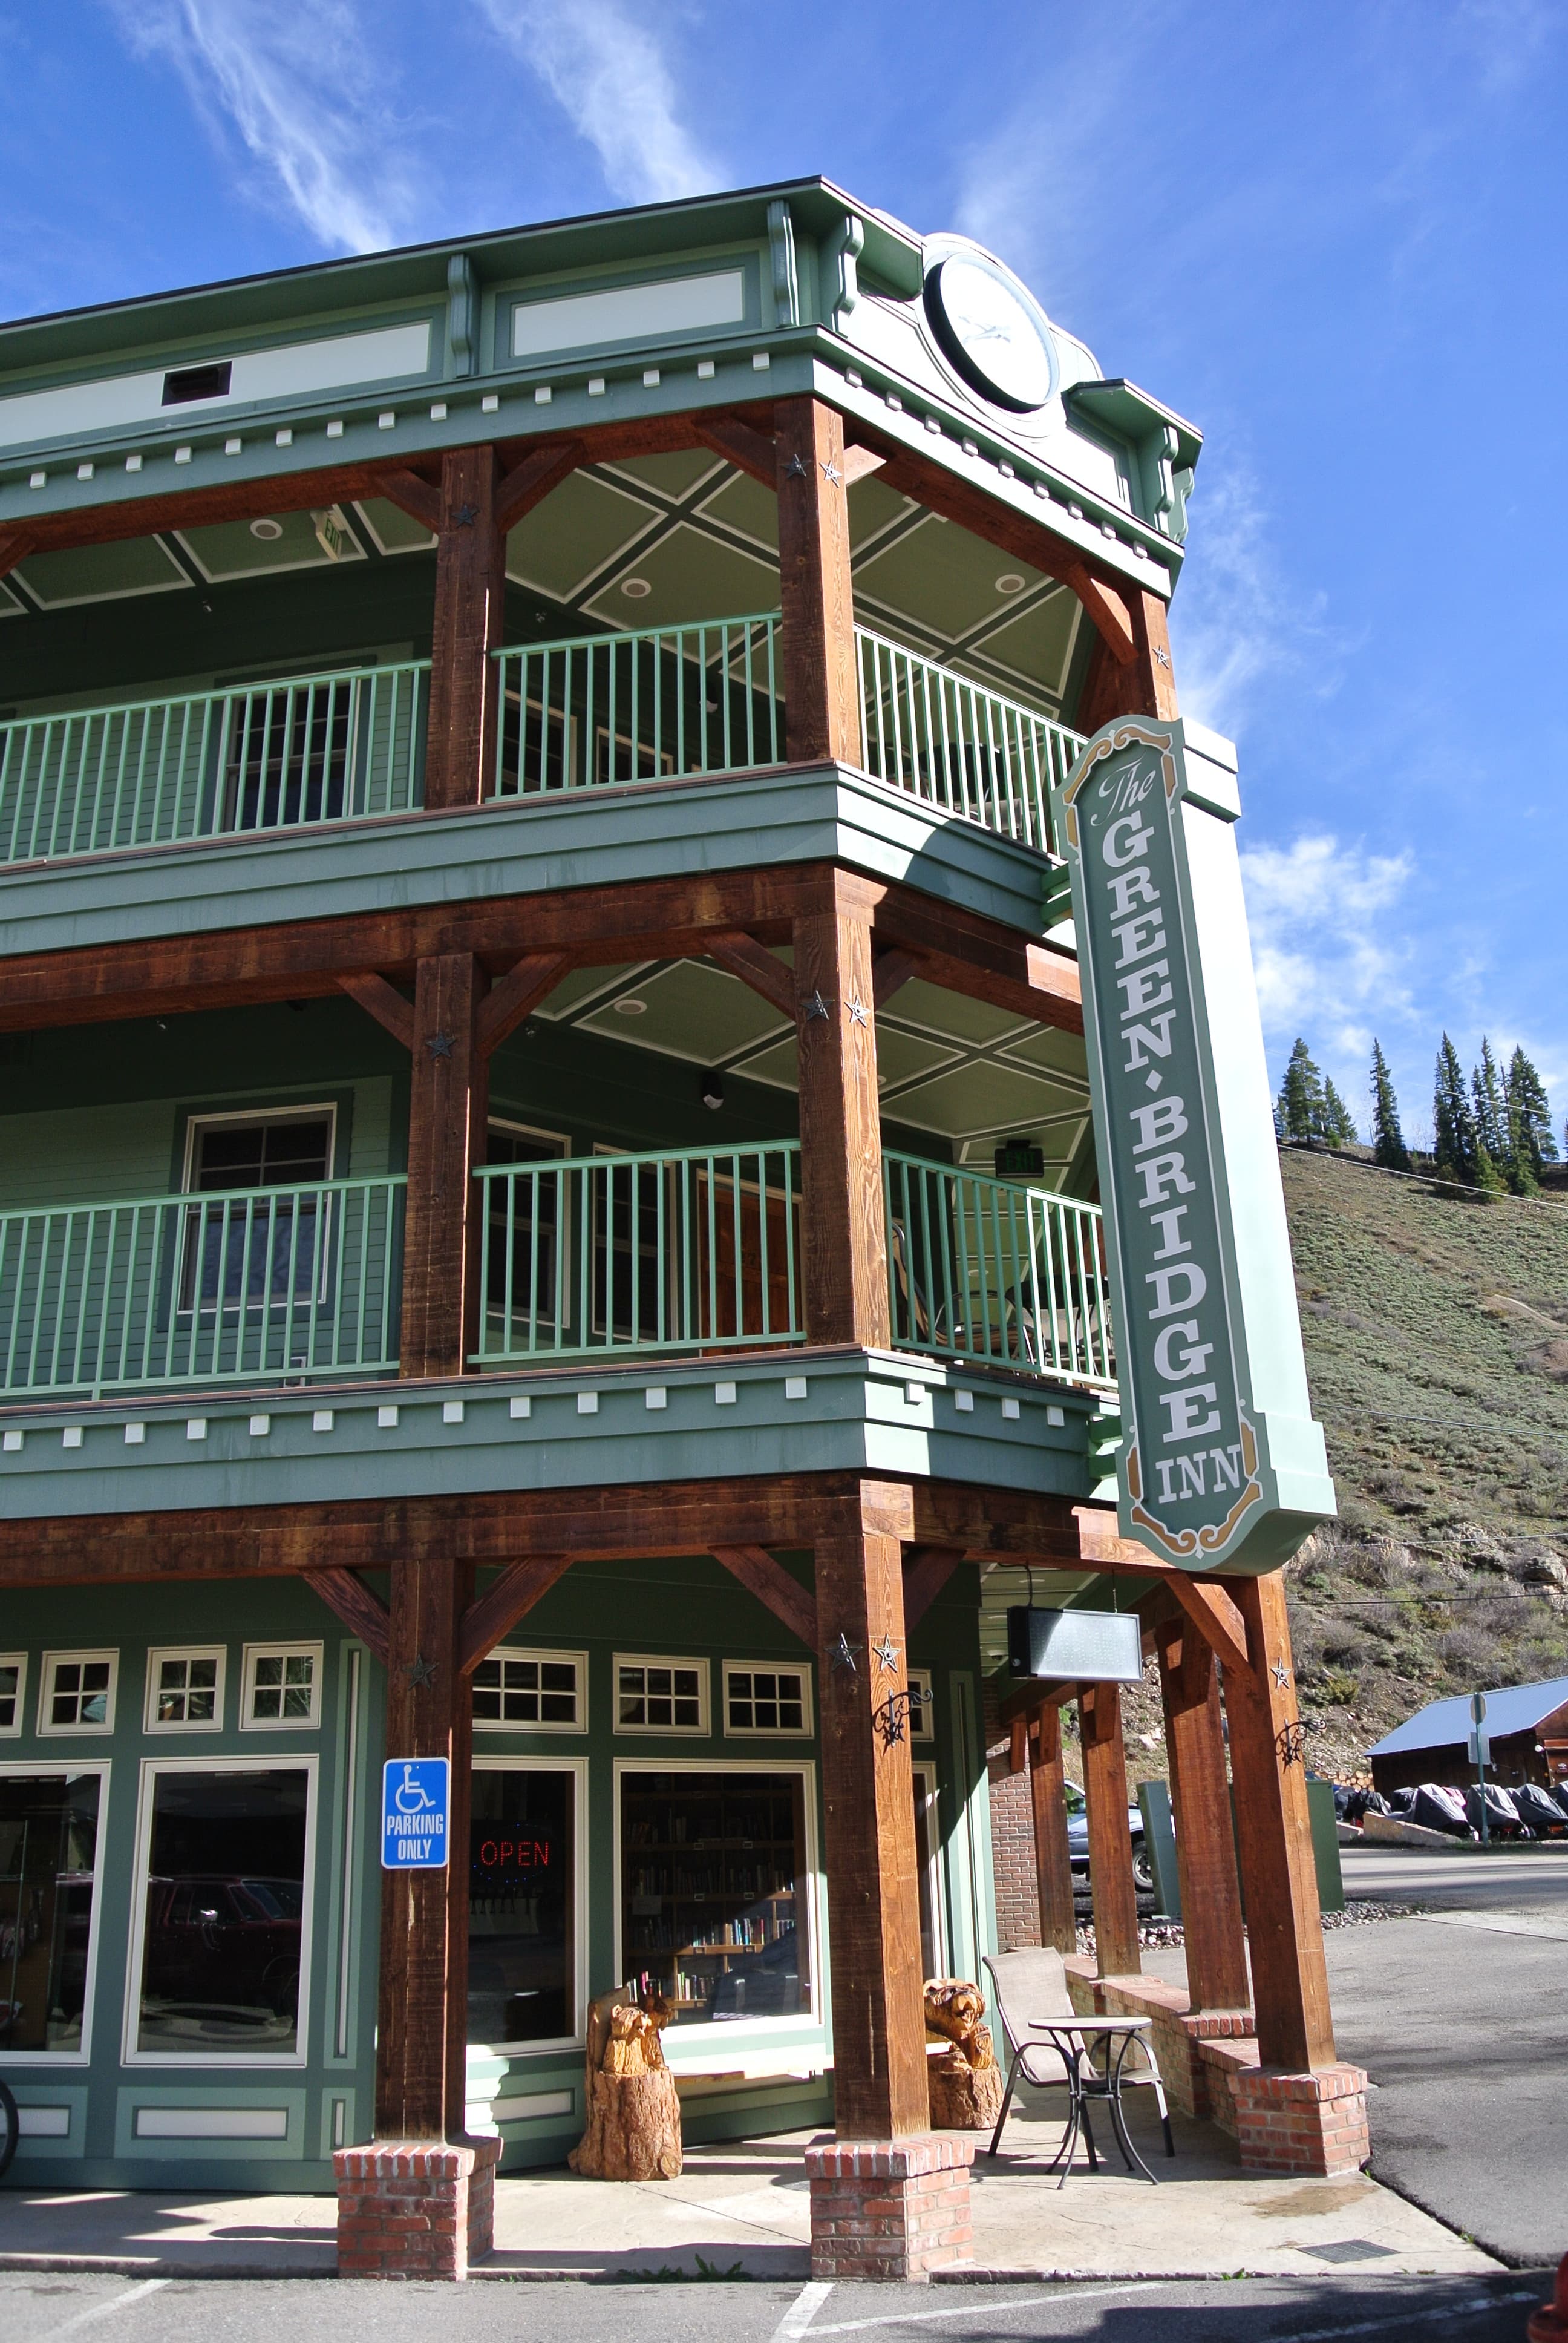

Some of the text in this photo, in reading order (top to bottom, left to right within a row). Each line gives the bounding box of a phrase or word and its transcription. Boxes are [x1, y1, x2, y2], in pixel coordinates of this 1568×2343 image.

[1090, 752, 1156, 826] The
[1102, 811, 1222, 1444] GREEN BRIDGE
[1155, 1444, 1241, 1504] INN
[386, 1814, 444, 1835] PARKING
[397, 1839, 432, 1860] ONLY
[480, 1840, 549, 1866] OPEN
